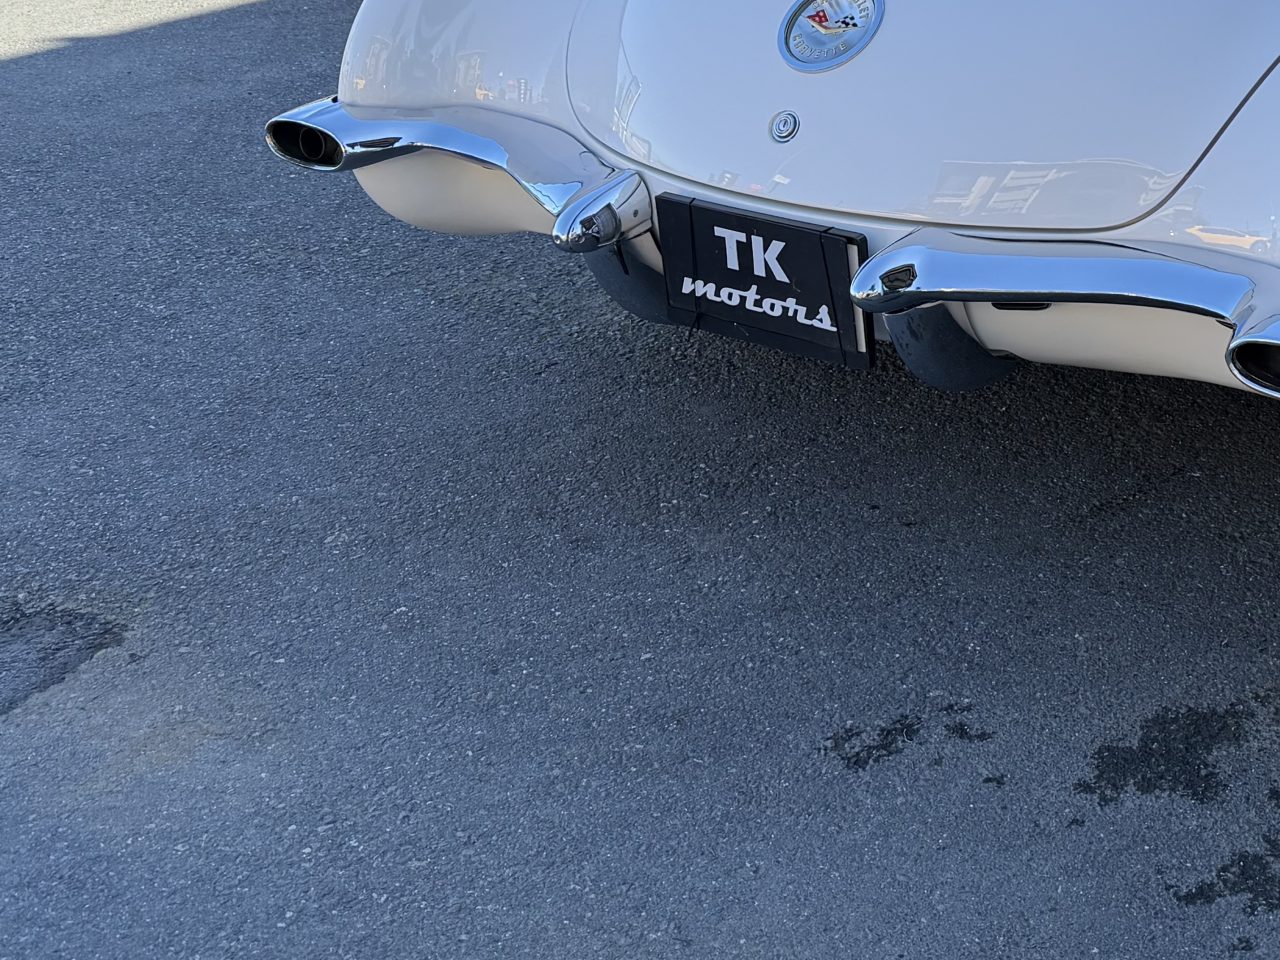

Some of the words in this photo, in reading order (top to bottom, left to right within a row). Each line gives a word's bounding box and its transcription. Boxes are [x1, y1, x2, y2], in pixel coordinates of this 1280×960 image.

[792, 33, 848, 58] CORVETTE
[713, 226, 790, 284] TK
[681, 276, 838, 332] motors
